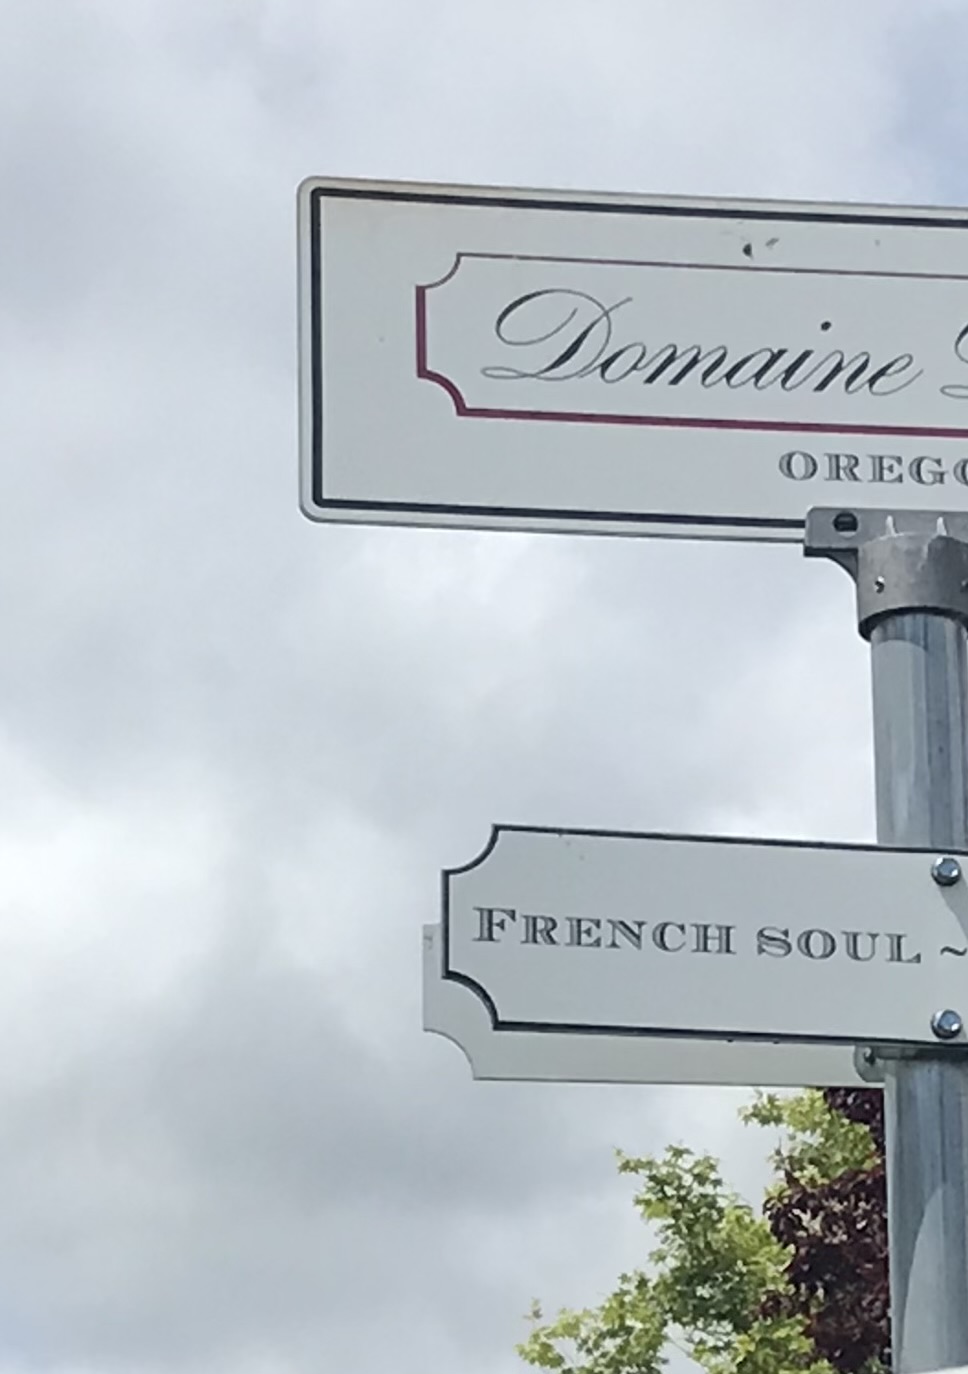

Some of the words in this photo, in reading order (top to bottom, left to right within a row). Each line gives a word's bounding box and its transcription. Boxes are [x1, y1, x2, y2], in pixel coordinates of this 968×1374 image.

[481, 288, 923, 397] Domaine
[472, 907, 737, 956] FRENCH
[756, 927, 921, 965] SOUL
